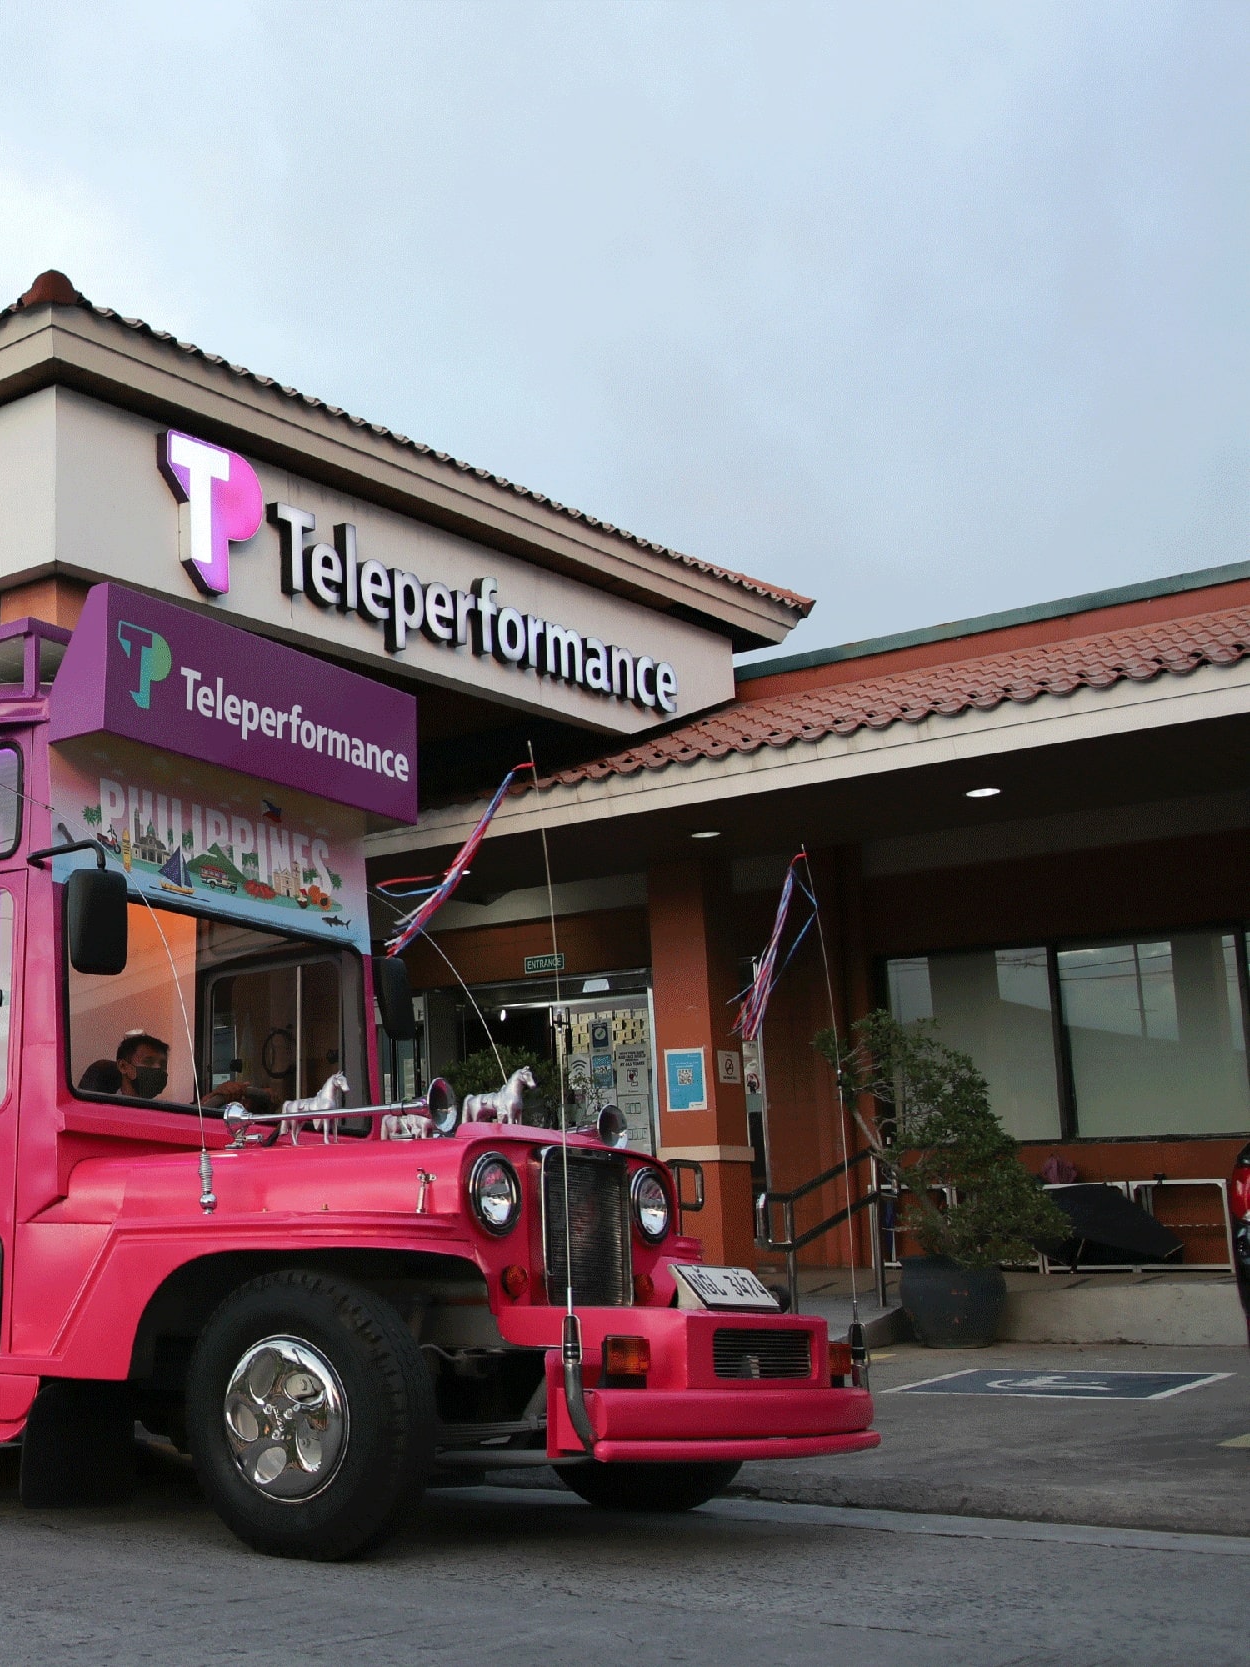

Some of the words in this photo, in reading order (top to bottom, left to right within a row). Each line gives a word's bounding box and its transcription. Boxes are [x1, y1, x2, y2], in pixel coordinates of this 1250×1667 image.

[267, 502, 678, 713] Teleperformance
[181, 666, 409, 783] Teleperformance
[100, 777, 334, 895] PHILIPPINES
[527, 957, 562, 970] ENTRANCE
